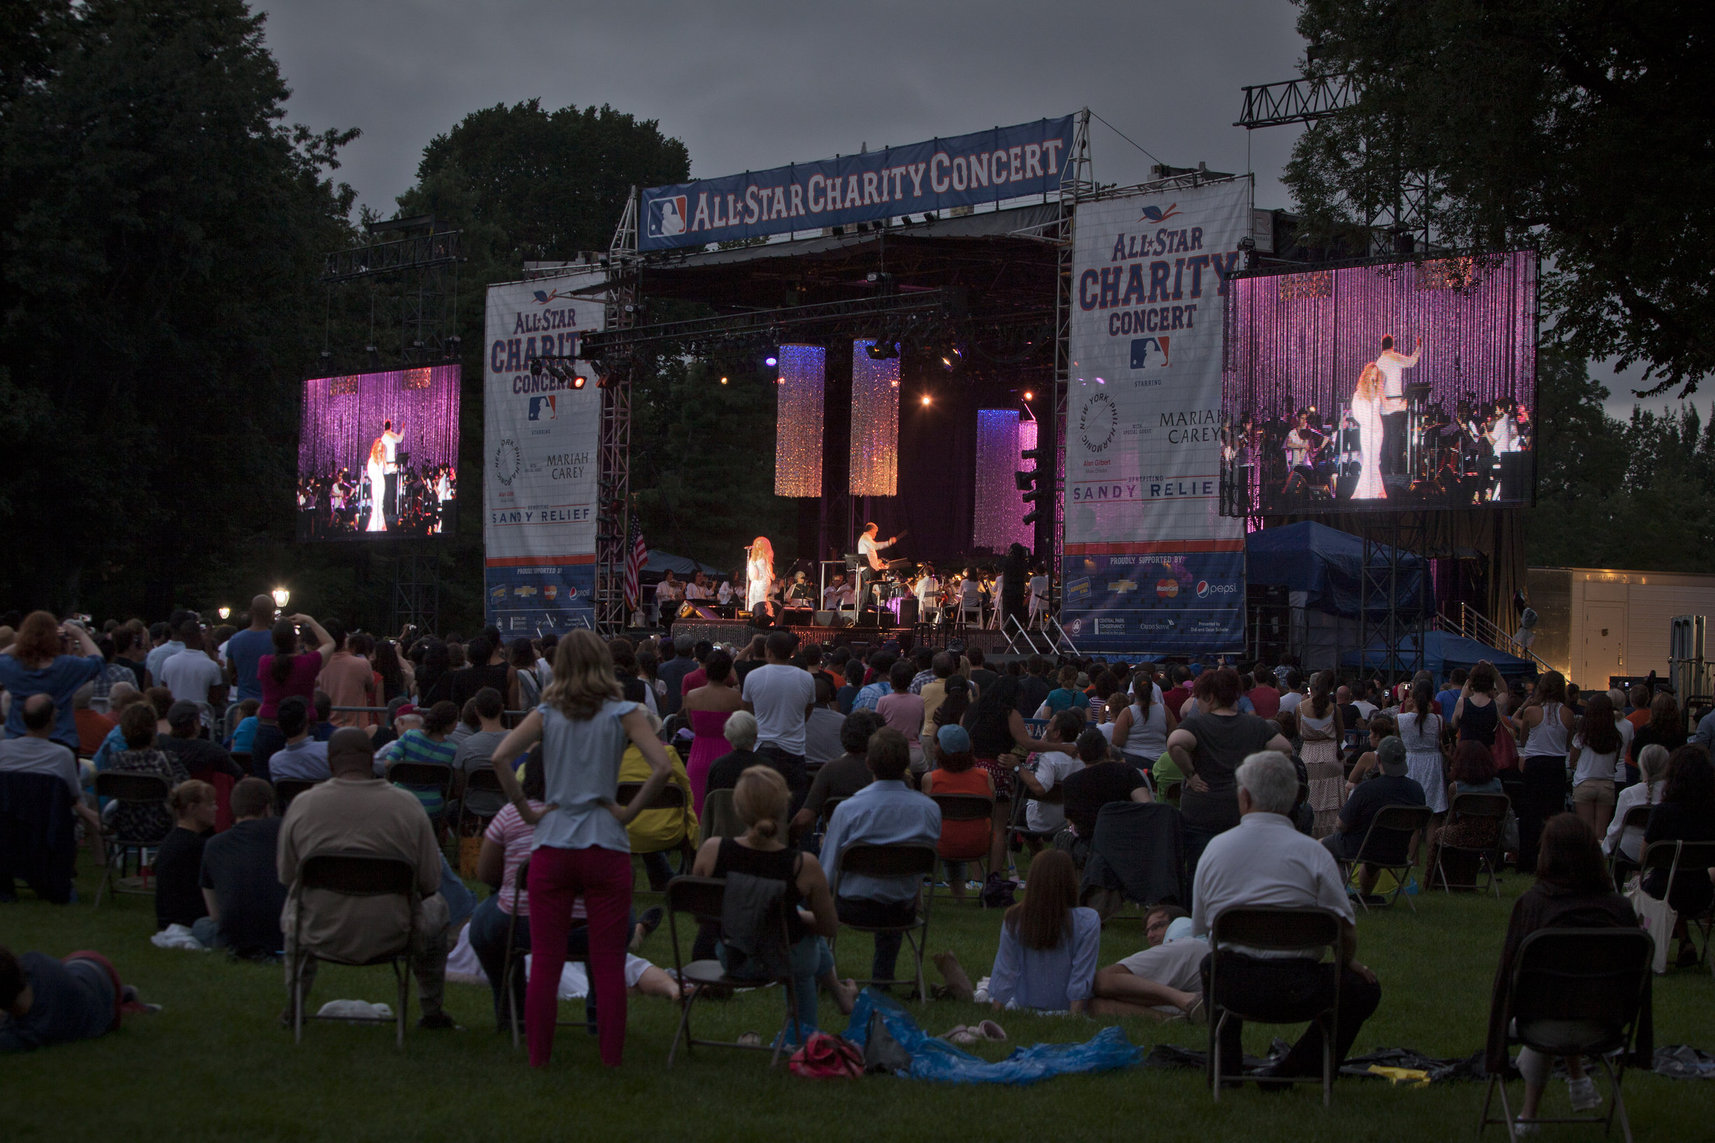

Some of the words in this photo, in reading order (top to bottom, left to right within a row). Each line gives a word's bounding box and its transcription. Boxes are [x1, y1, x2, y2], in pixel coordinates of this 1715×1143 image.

[807, 162, 926, 213] CHARITY
[930, 138, 1063, 193] CONCERT
[1079, 251, 1239, 311] CHARITY
[1109, 304, 1197, 336] CONCERT
[491, 329, 597, 374] CHARIT
[513, 375, 571, 394] CONCER
[1089, 393, 1110, 405] YORK
[1168, 427, 1221, 444] CAREY
[547, 452, 588, 467] MARIAH
[552, 467, 584, 480] CAREY
[1073, 485, 1136, 500] SANDY
[1151, 481, 1222, 497] RELIE
[493, 511, 532, 524] SANDY
[542, 509, 590, 521] RELIEF
[1110, 556, 1136, 565] PROUDLY
[1138, 555, 1172, 565] SUPPORTED
[1210, 582, 1237, 595] pepsi
